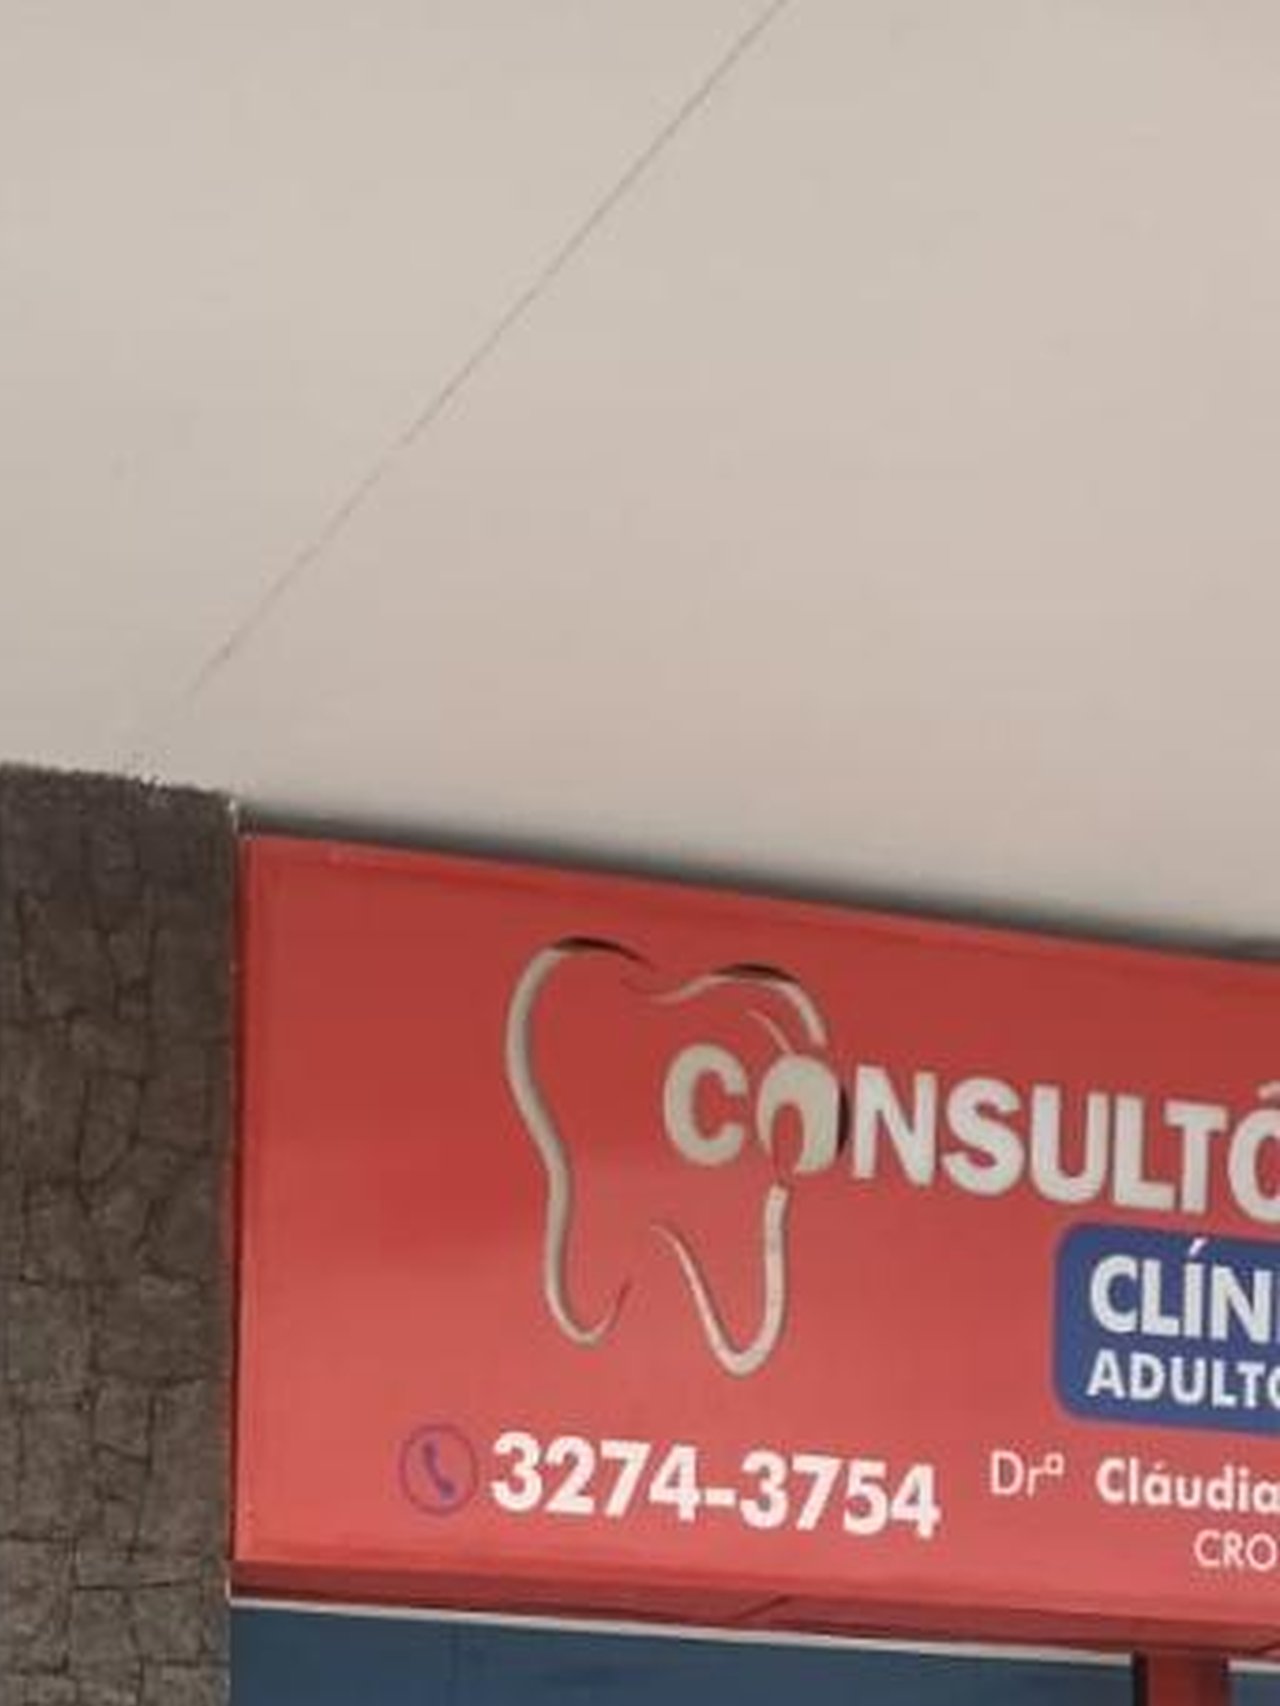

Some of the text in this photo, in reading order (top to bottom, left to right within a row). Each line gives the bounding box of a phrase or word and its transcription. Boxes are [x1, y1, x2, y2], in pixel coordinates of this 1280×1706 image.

[1091, 1236, 1280, 1343] CLÍN
[491, 1430, 940, 1539] 3274-3754
[1096, 1456, 1280, 1513] Cláudia
[1193, 1529, 1278, 1572] CRO
